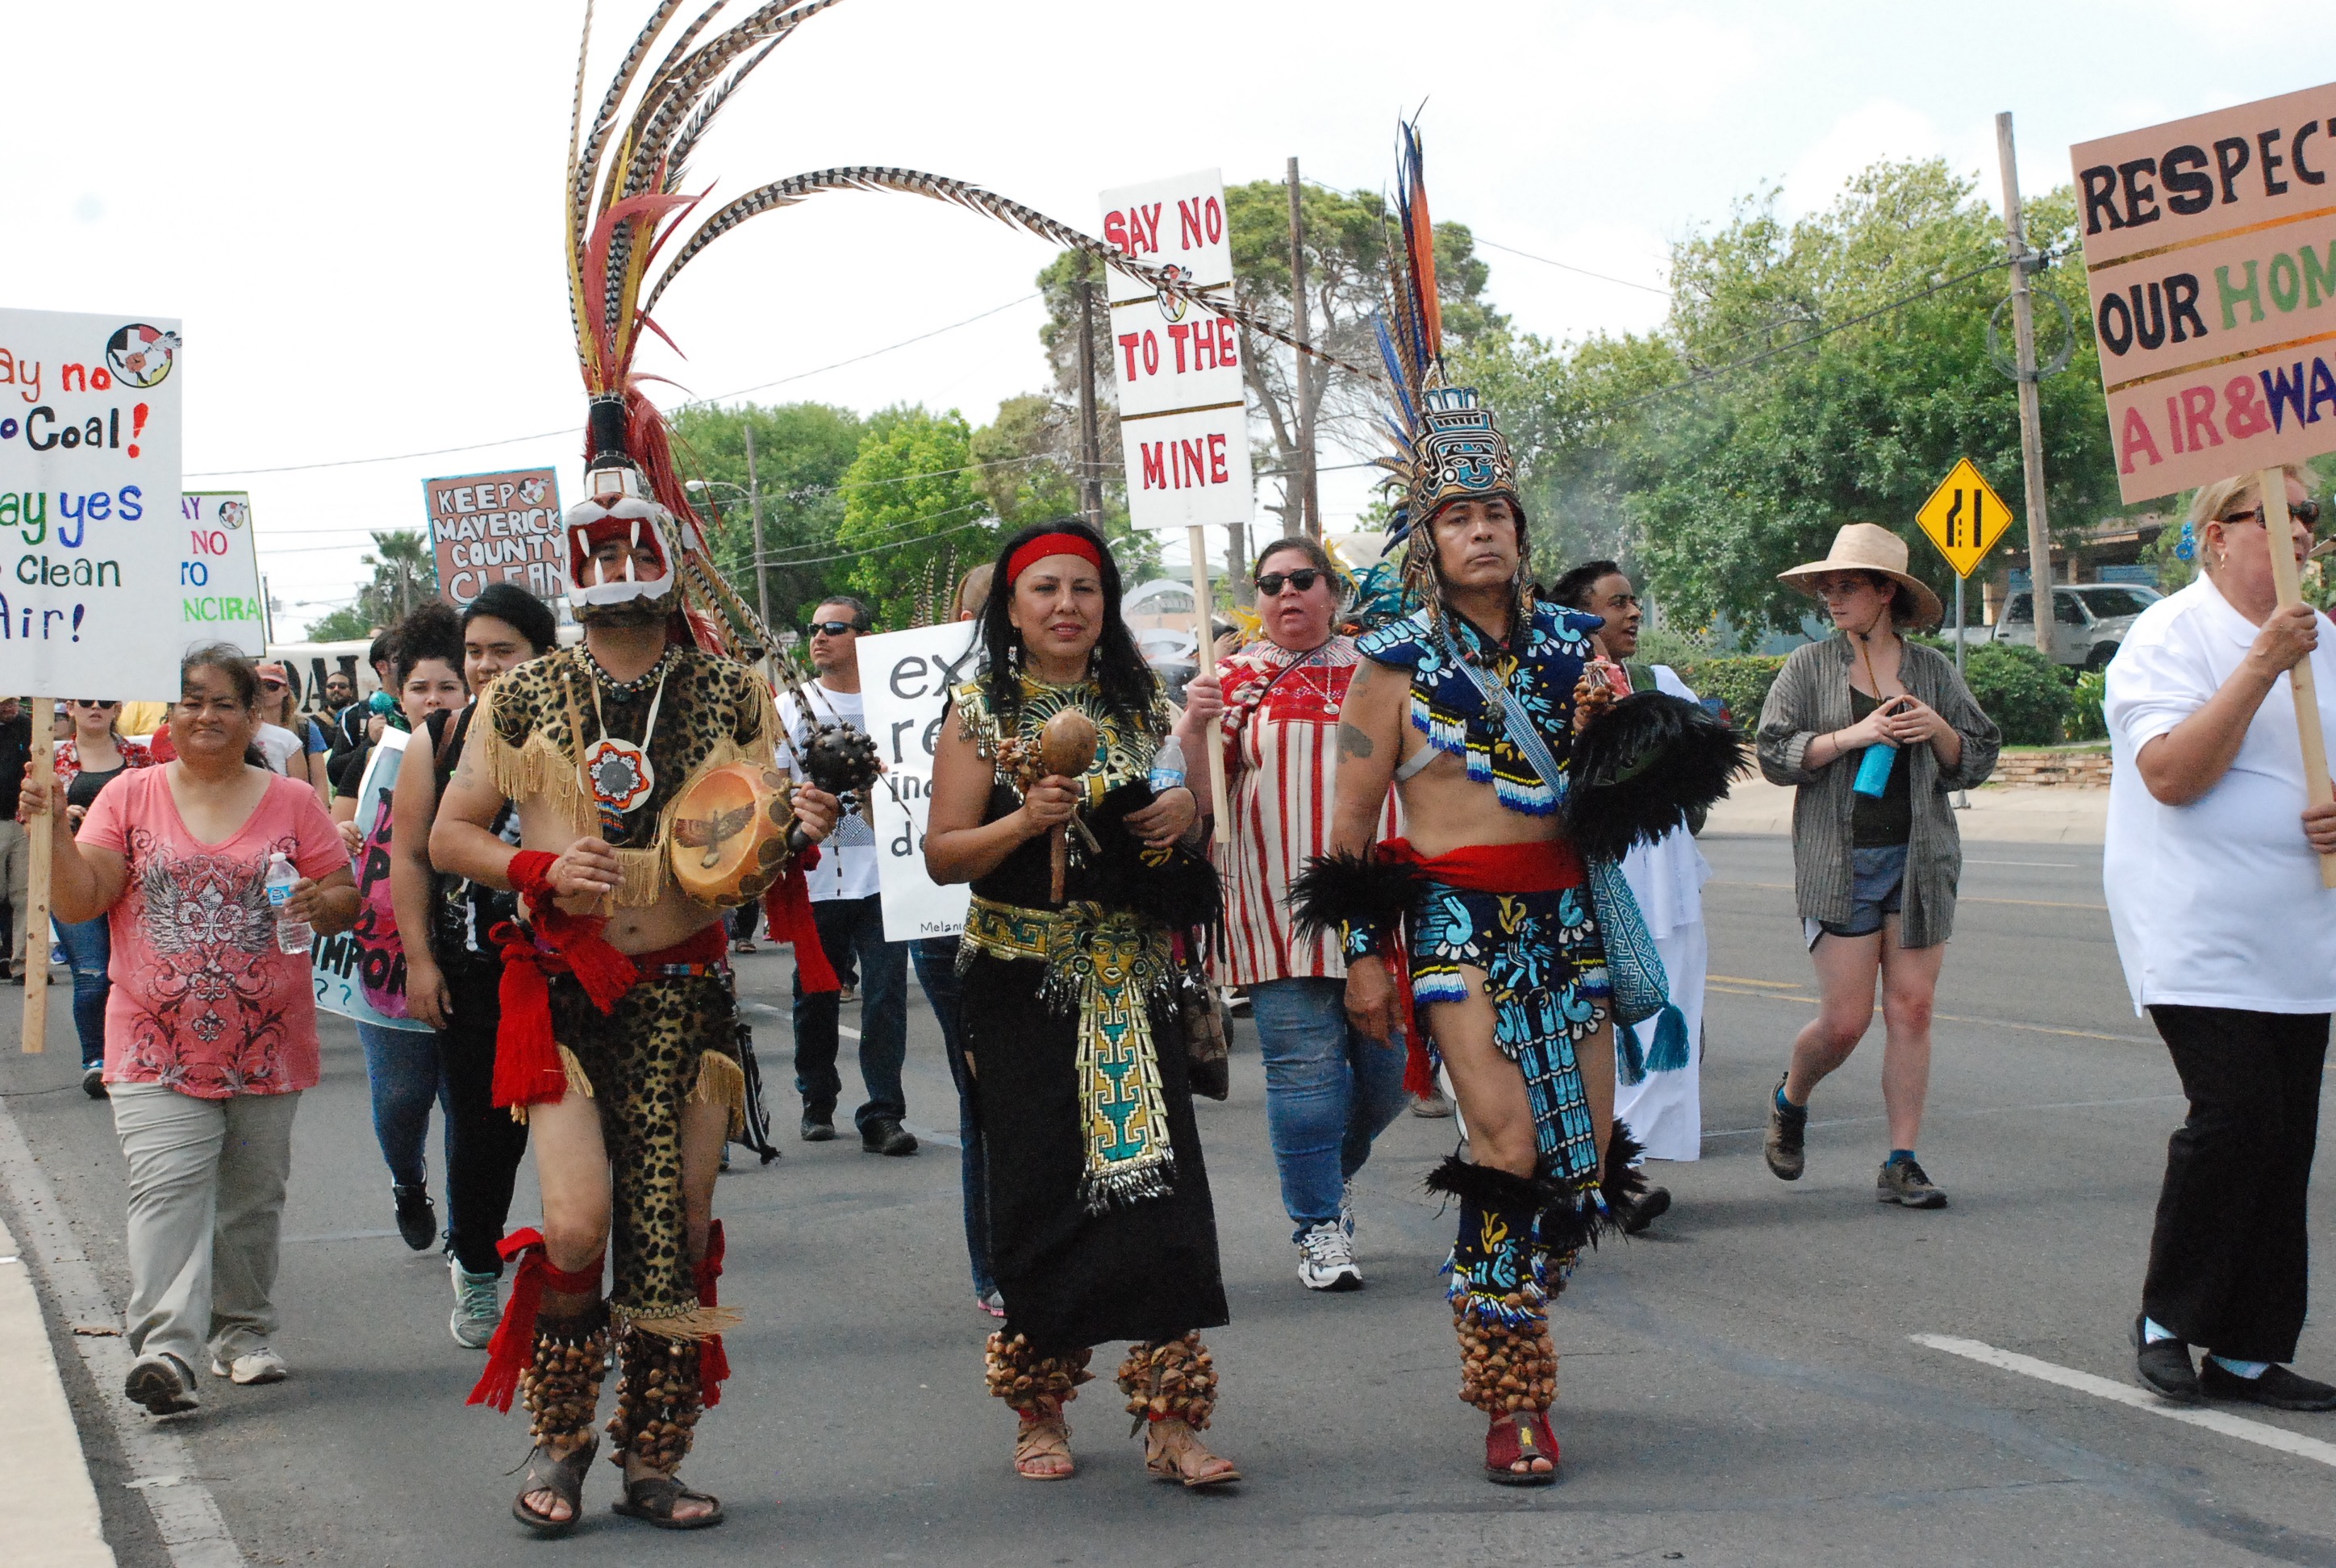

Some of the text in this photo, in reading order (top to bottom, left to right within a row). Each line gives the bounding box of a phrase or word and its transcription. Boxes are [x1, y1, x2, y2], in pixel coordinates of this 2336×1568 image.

[1103, 195, 1222, 257] SAY NO
[2098, 272, 2209, 357] OUR
[1118, 317, 1237, 382] TO THE
[62, 363, 111, 392] no
[1140, 433, 1228, 490] MINE
[58, 485, 143, 548] yes
[436, 482, 516, 515] KEEP
[190, 530, 228, 556] NO
[432, 507, 562, 544] MAVERICK
[451, 533, 564, 569] COUNTY
[17, 554, 121, 587] Clean
[182, 596, 262, 622] NCIRA
[920, 920, 966, 933] Melani
